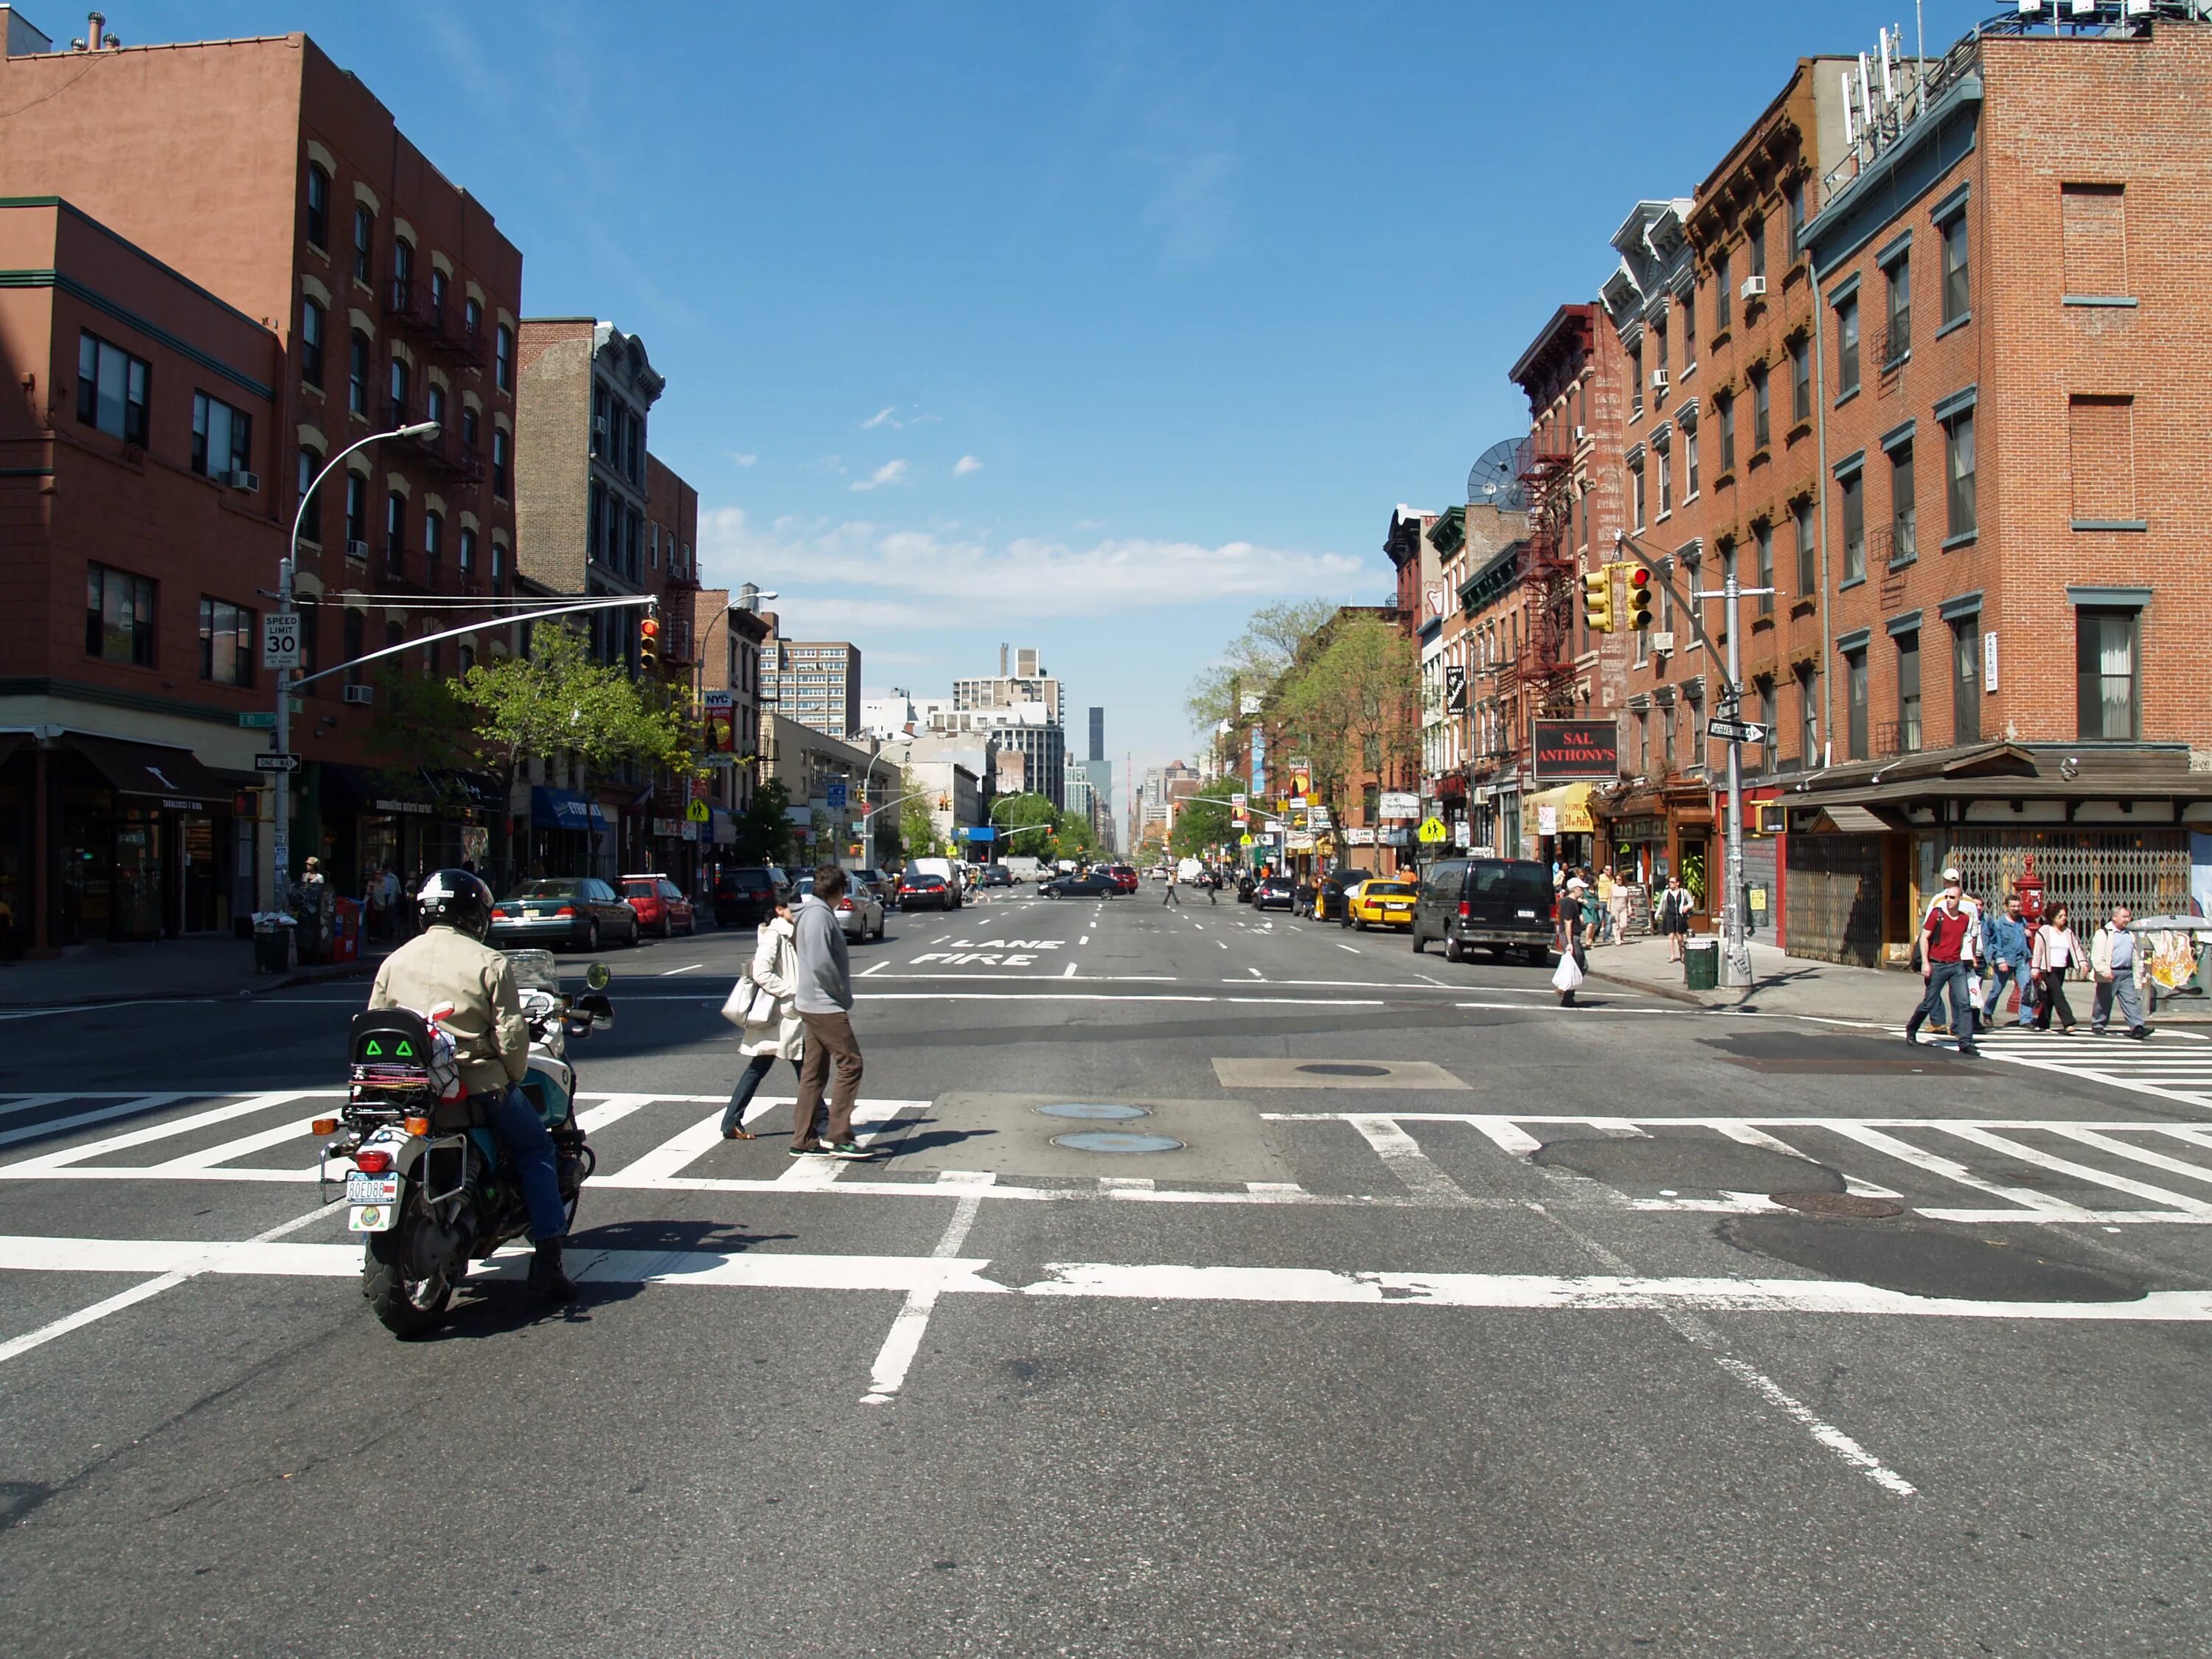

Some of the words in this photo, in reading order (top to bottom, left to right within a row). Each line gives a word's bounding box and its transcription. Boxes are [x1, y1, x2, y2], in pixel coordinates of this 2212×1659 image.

[267, 636, 295, 653] 30
[706, 695, 728, 704] NYC
[247, 714, 255, 726] 10
[1714, 724, 1733, 735] ONE
[1740, 726, 1758, 738] WAY
[1563, 731, 1594, 745] SAL
[1537, 748, 1617, 762] ANTHONY'S
[279, 759, 293, 767] WAY
[567, 801, 602, 816] EYEWRKS
[950, 939, 1066, 949] LANE
[908, 953, 1038, 966] FIRE
